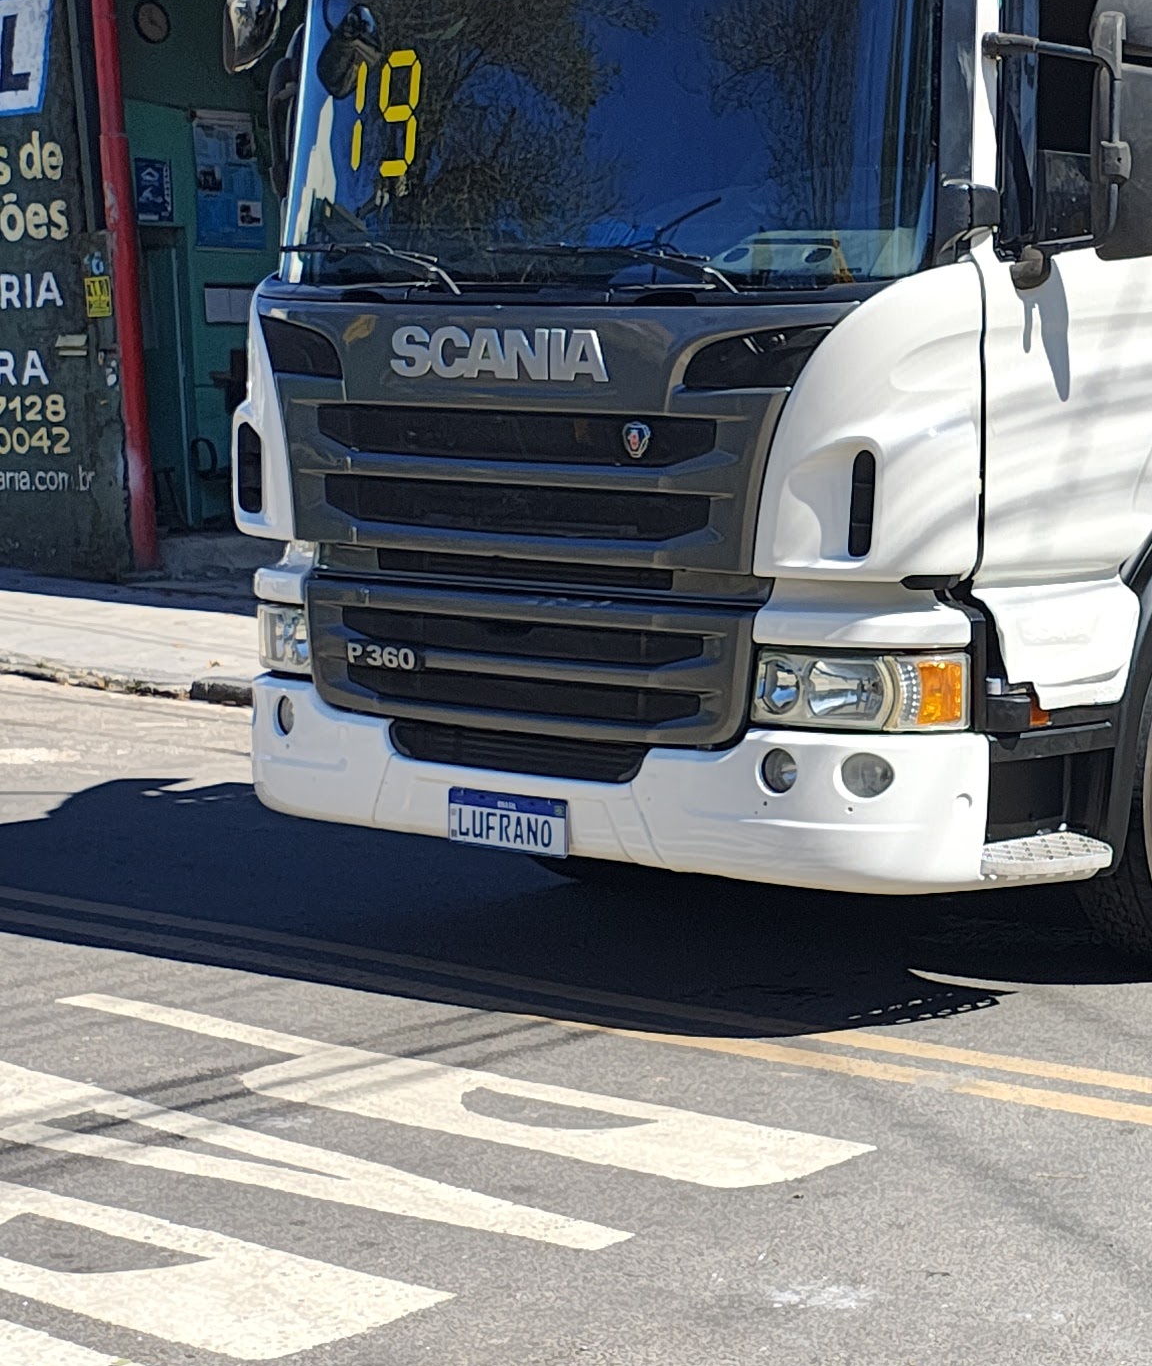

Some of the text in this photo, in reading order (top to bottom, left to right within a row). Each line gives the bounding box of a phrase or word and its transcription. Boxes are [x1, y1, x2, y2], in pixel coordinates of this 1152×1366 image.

[351, 49, 421, 178] 19
[19, 130, 64, 181] de
[389, 325, 610, 383] SCANIA
[347, 642, 416, 670] P 360
[458, 807, 553, 848] LUFRANO
